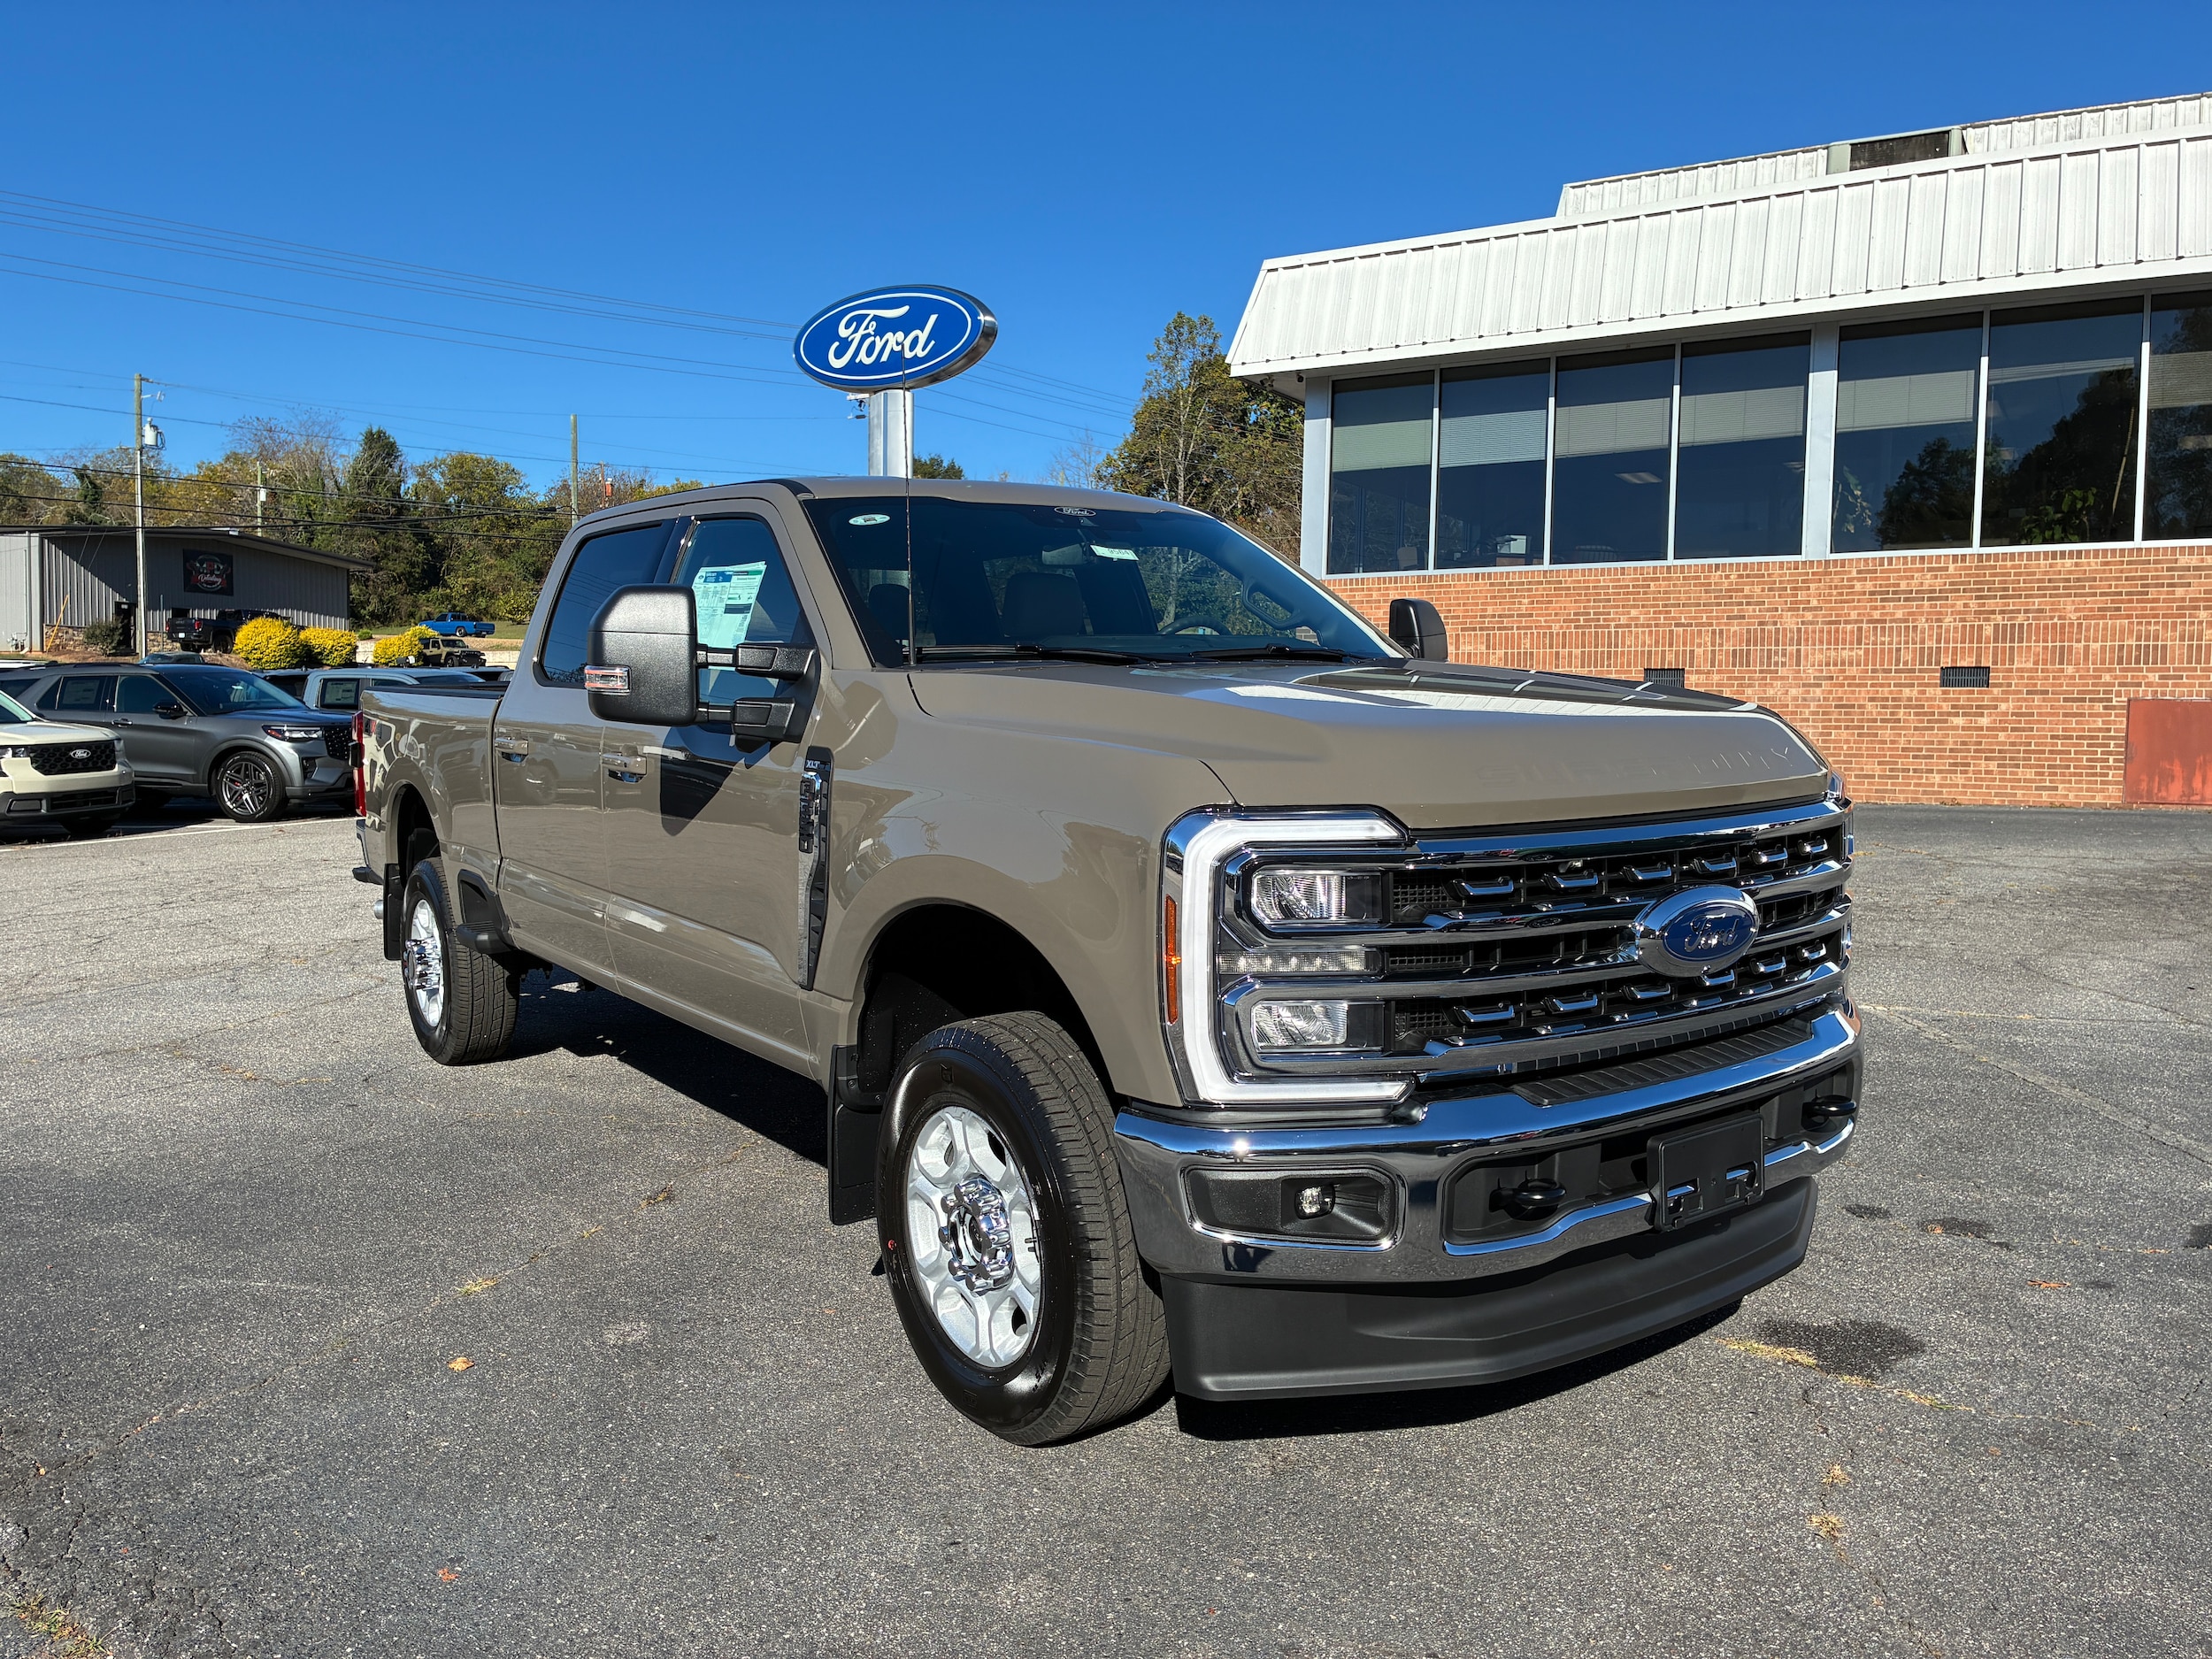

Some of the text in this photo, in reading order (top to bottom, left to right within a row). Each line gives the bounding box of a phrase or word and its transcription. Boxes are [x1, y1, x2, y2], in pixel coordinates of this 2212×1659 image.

[828, 304, 939, 369] Ford
[806, 759, 820, 769] XLT
[1685, 912, 1740, 953] Ford
